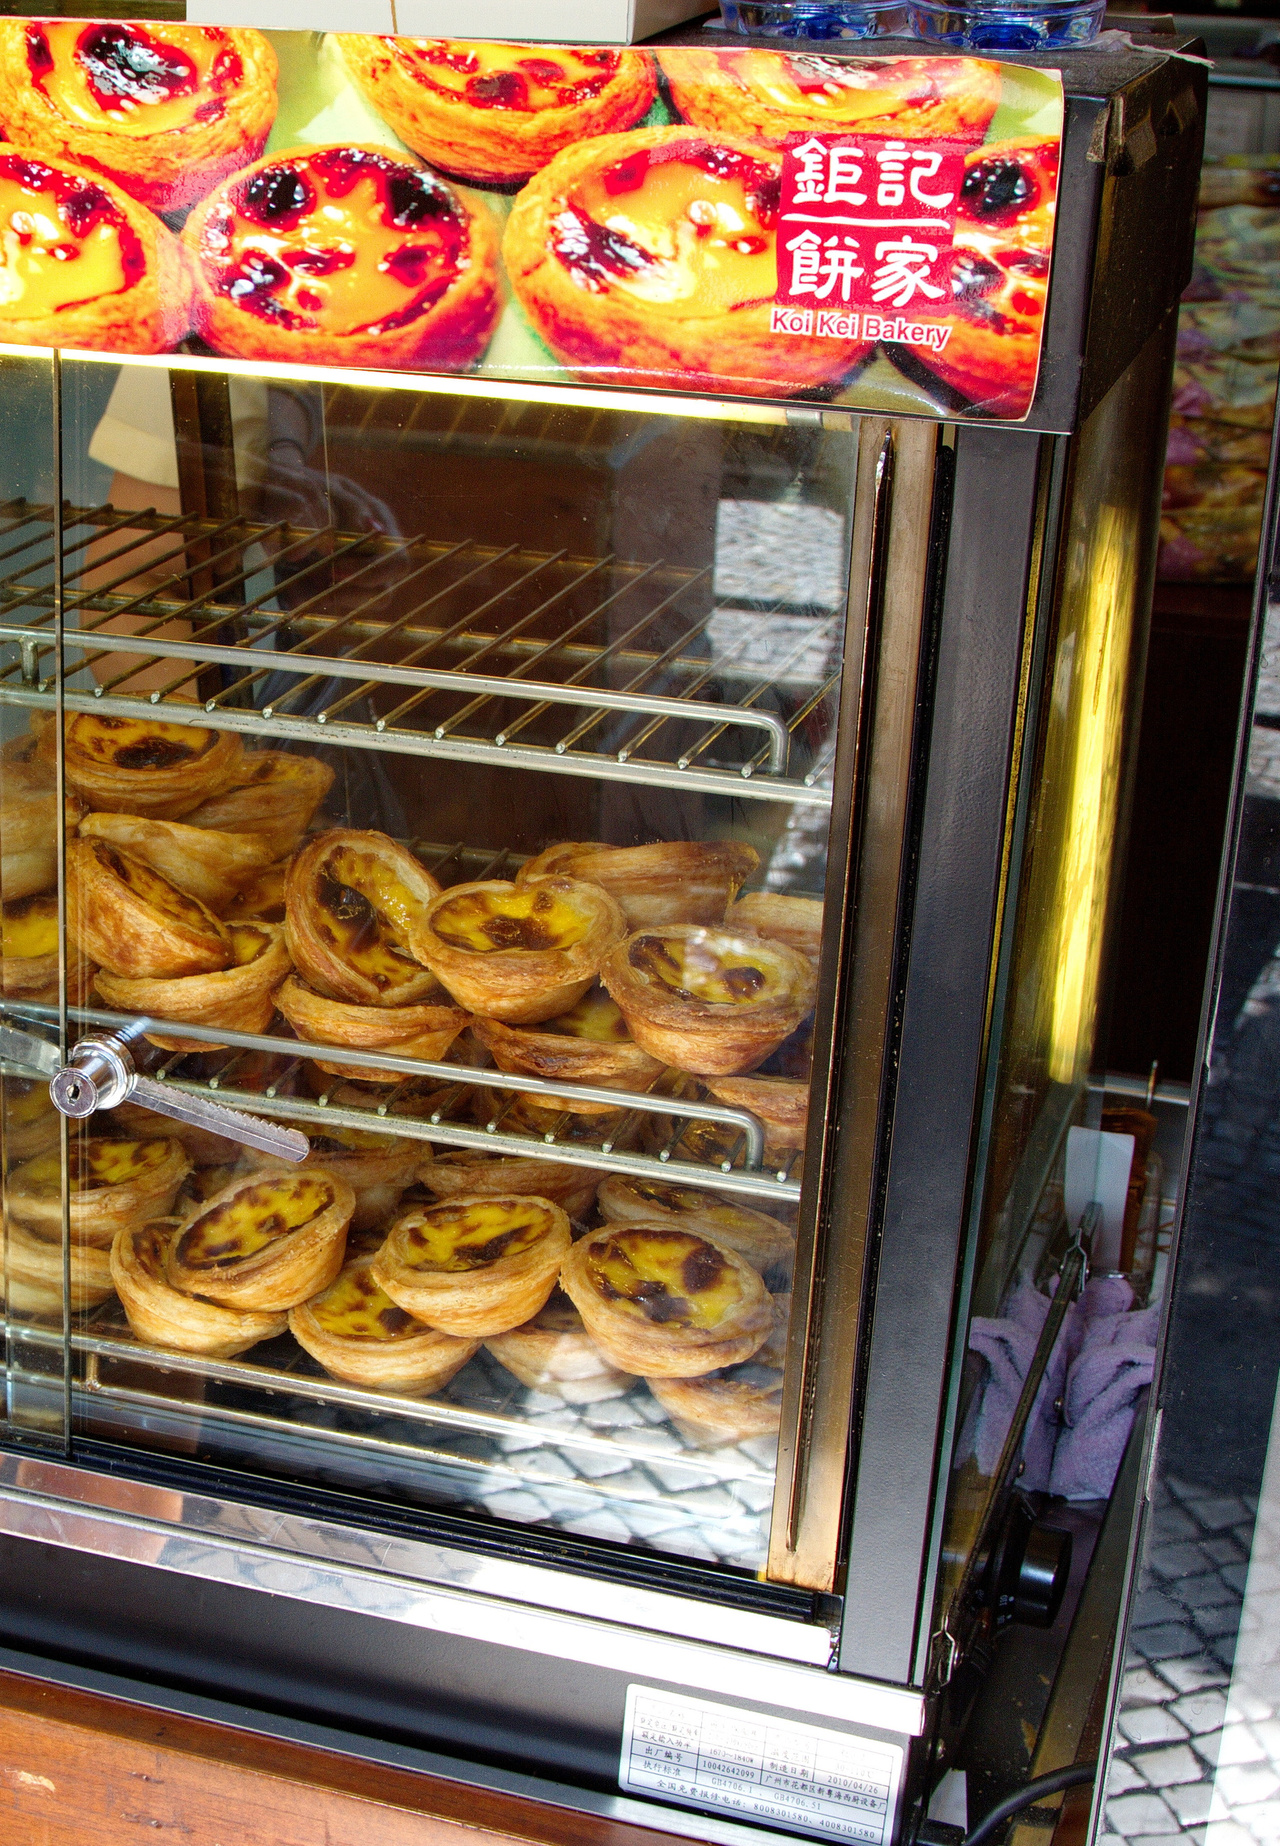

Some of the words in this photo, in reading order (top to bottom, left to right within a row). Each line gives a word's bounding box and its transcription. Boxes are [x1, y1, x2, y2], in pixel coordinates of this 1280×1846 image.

[791, 138, 955, 209] 鉅記
[786, 228, 946, 307] 餅家
[771, 309, 812, 334] Koi
[817, 312, 859, 338] Kei
[864, 316, 951, 350] Bakery
[703, 1760, 755, 1779] 10042642099
[828, 1775, 878, 1795] 2010/04/26
